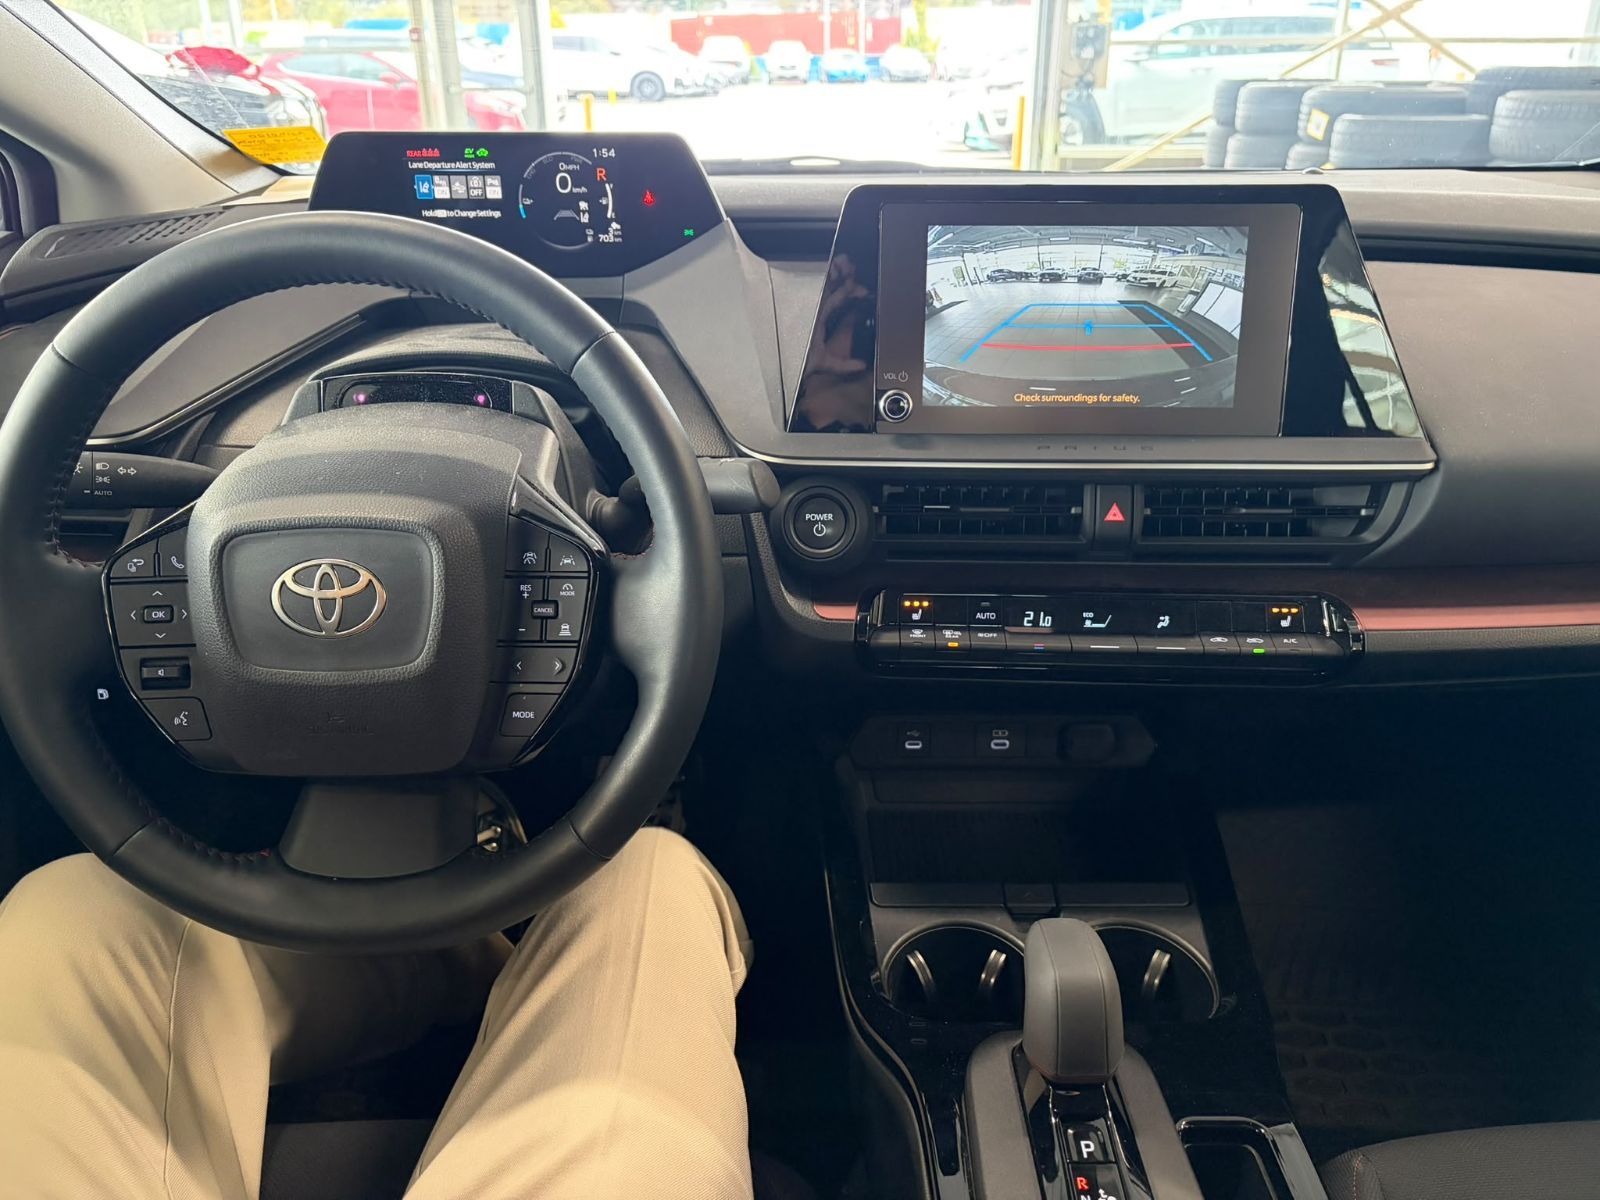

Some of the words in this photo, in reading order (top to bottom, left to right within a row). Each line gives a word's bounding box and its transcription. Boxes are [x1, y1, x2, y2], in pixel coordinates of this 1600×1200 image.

[593, 148, 616, 158] 1:54
[408, 161, 424, 169] Lane
[424, 161, 455, 171] Departure
[455, 161, 472, 169] Alert
[472, 162, 495, 171] System
[559, 162, 565, 170] 0
[596, 168, 607, 181] R
[556, 172, 572, 193] 0
[470, 189, 483, 197] OFF
[454, 209, 476, 218] Change
[476, 209, 501, 218] Settings
[883, 372, 897, 380] VOL
[1013, 393, 1040, 402] Check
[1041, 393, 1098, 404] surroundings
[1099, 393, 1111, 402] for
[1112, 393, 1140, 404] safety.
[805, 513, 834, 521] POWER
[520, 584, 532, 592] RES
[151, 610, 166, 619] OK
[975, 611, 996, 620] AUTO
[512, 711, 535, 719] MODE
[1080, 1140, 1095, 1159] P
[1076, 1176, 1089, 1191] R
